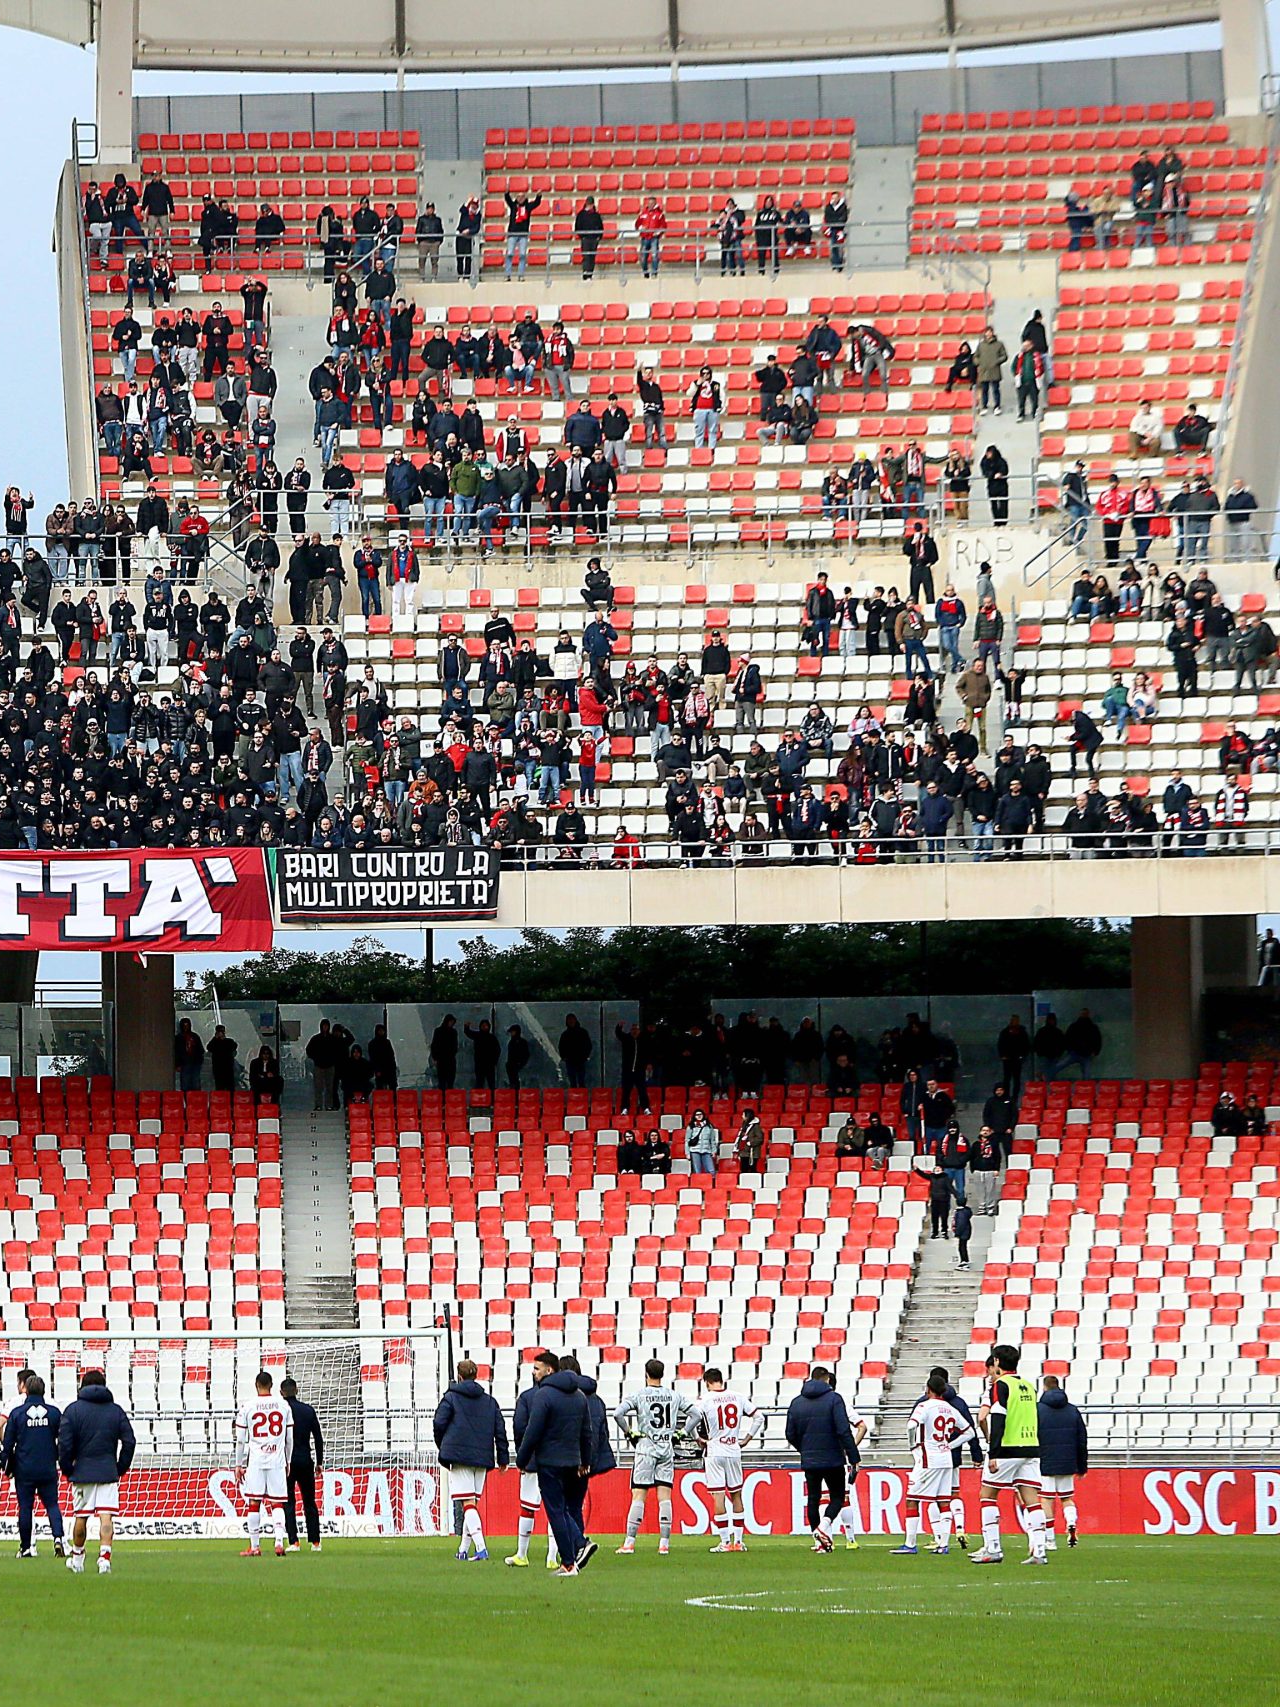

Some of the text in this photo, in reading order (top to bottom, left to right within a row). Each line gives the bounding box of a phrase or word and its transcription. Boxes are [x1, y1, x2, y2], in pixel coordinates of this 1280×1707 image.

[284, 851, 490, 878] BARI CONTRO LA
[251, 1411, 284, 1438] 28
[649, 1402, 671, 1429] 31
[717, 1403, 738, 1430] 18
[932, 1415, 956, 1442] 93
[681, 1471, 772, 1535] SC
[1143, 1471, 1237, 1535] SSC
[204, 1520, 241, 1535] live
[341, 1520, 377, 1535] live
